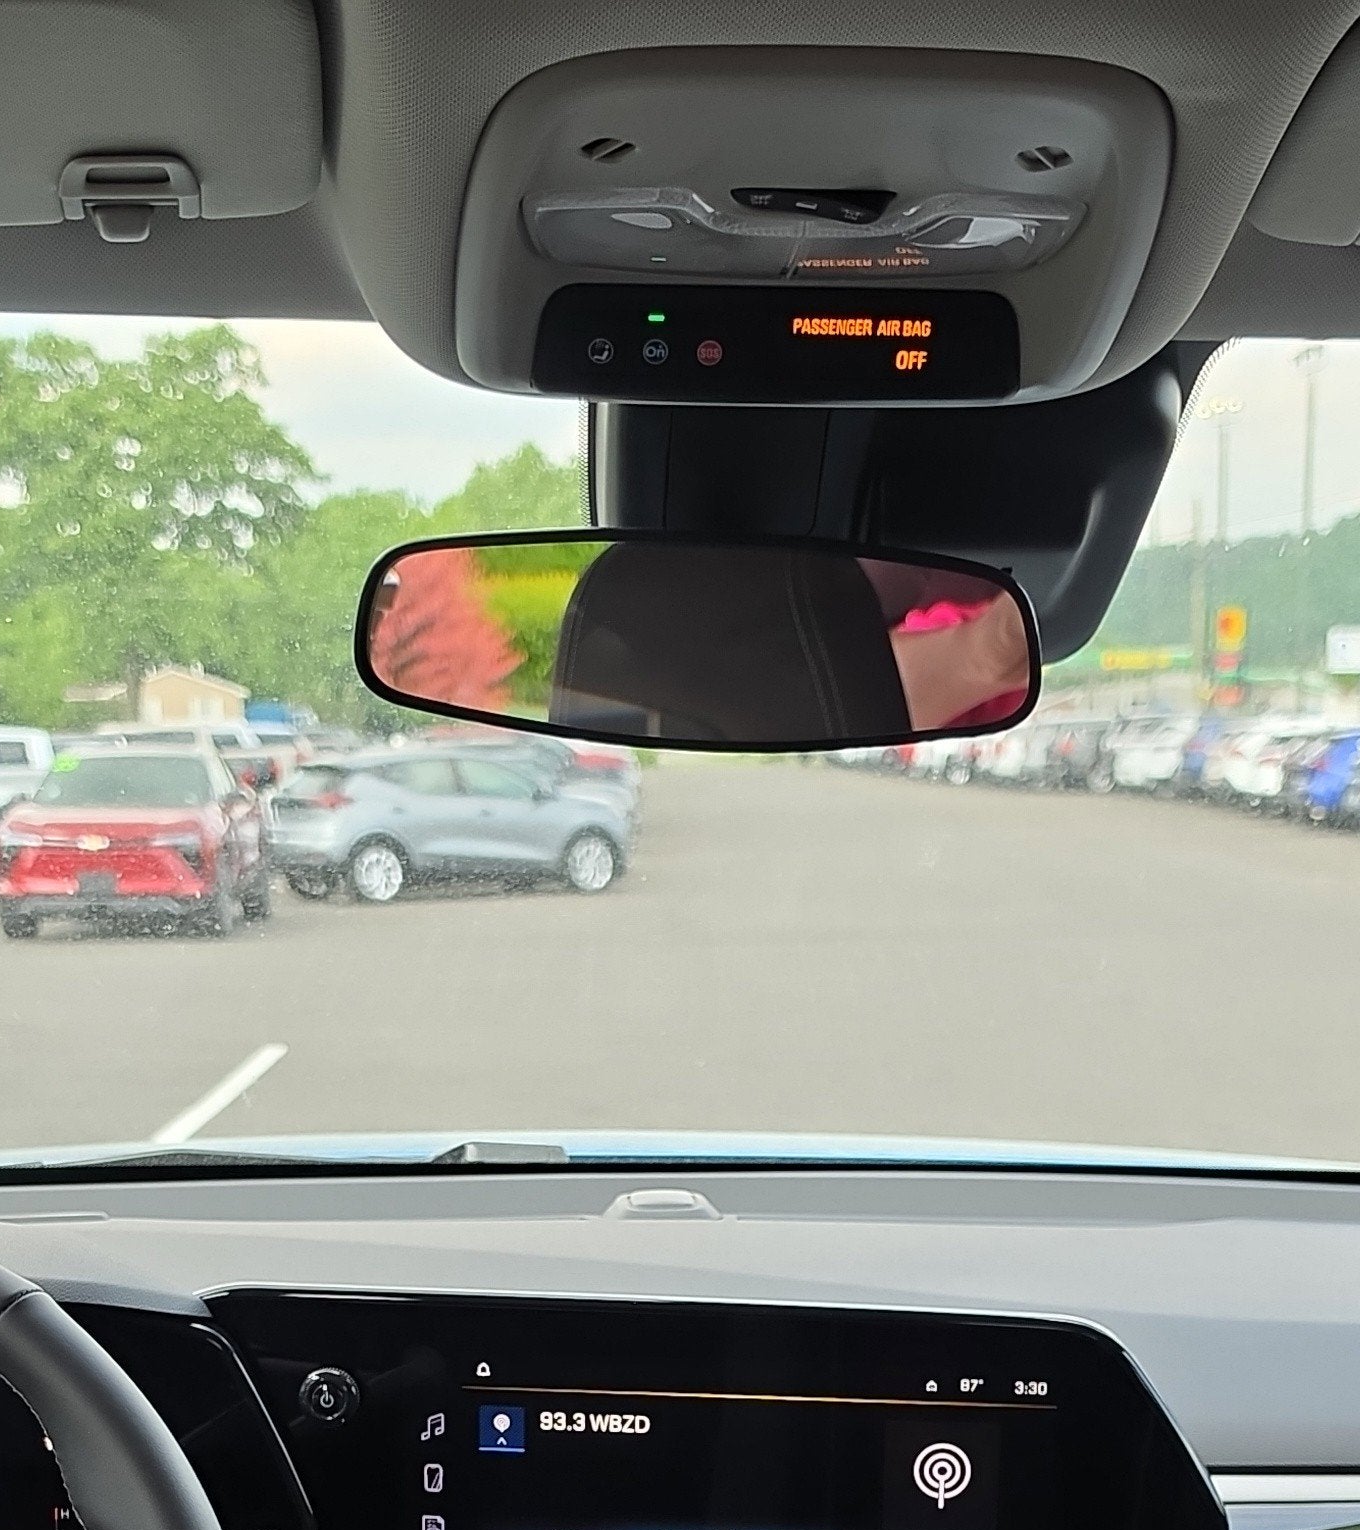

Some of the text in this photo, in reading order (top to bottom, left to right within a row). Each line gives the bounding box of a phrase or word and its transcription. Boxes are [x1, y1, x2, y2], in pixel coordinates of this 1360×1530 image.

[792, 317, 932, 338] PASSENGER AIR BAG
[895, 349, 928, 371] OFF
[1013, 1380, 1048, 1396] 3:30
[539, 1411, 651, 1434] 93.3 WBZD
[60, 1508, 70, 1520] H
